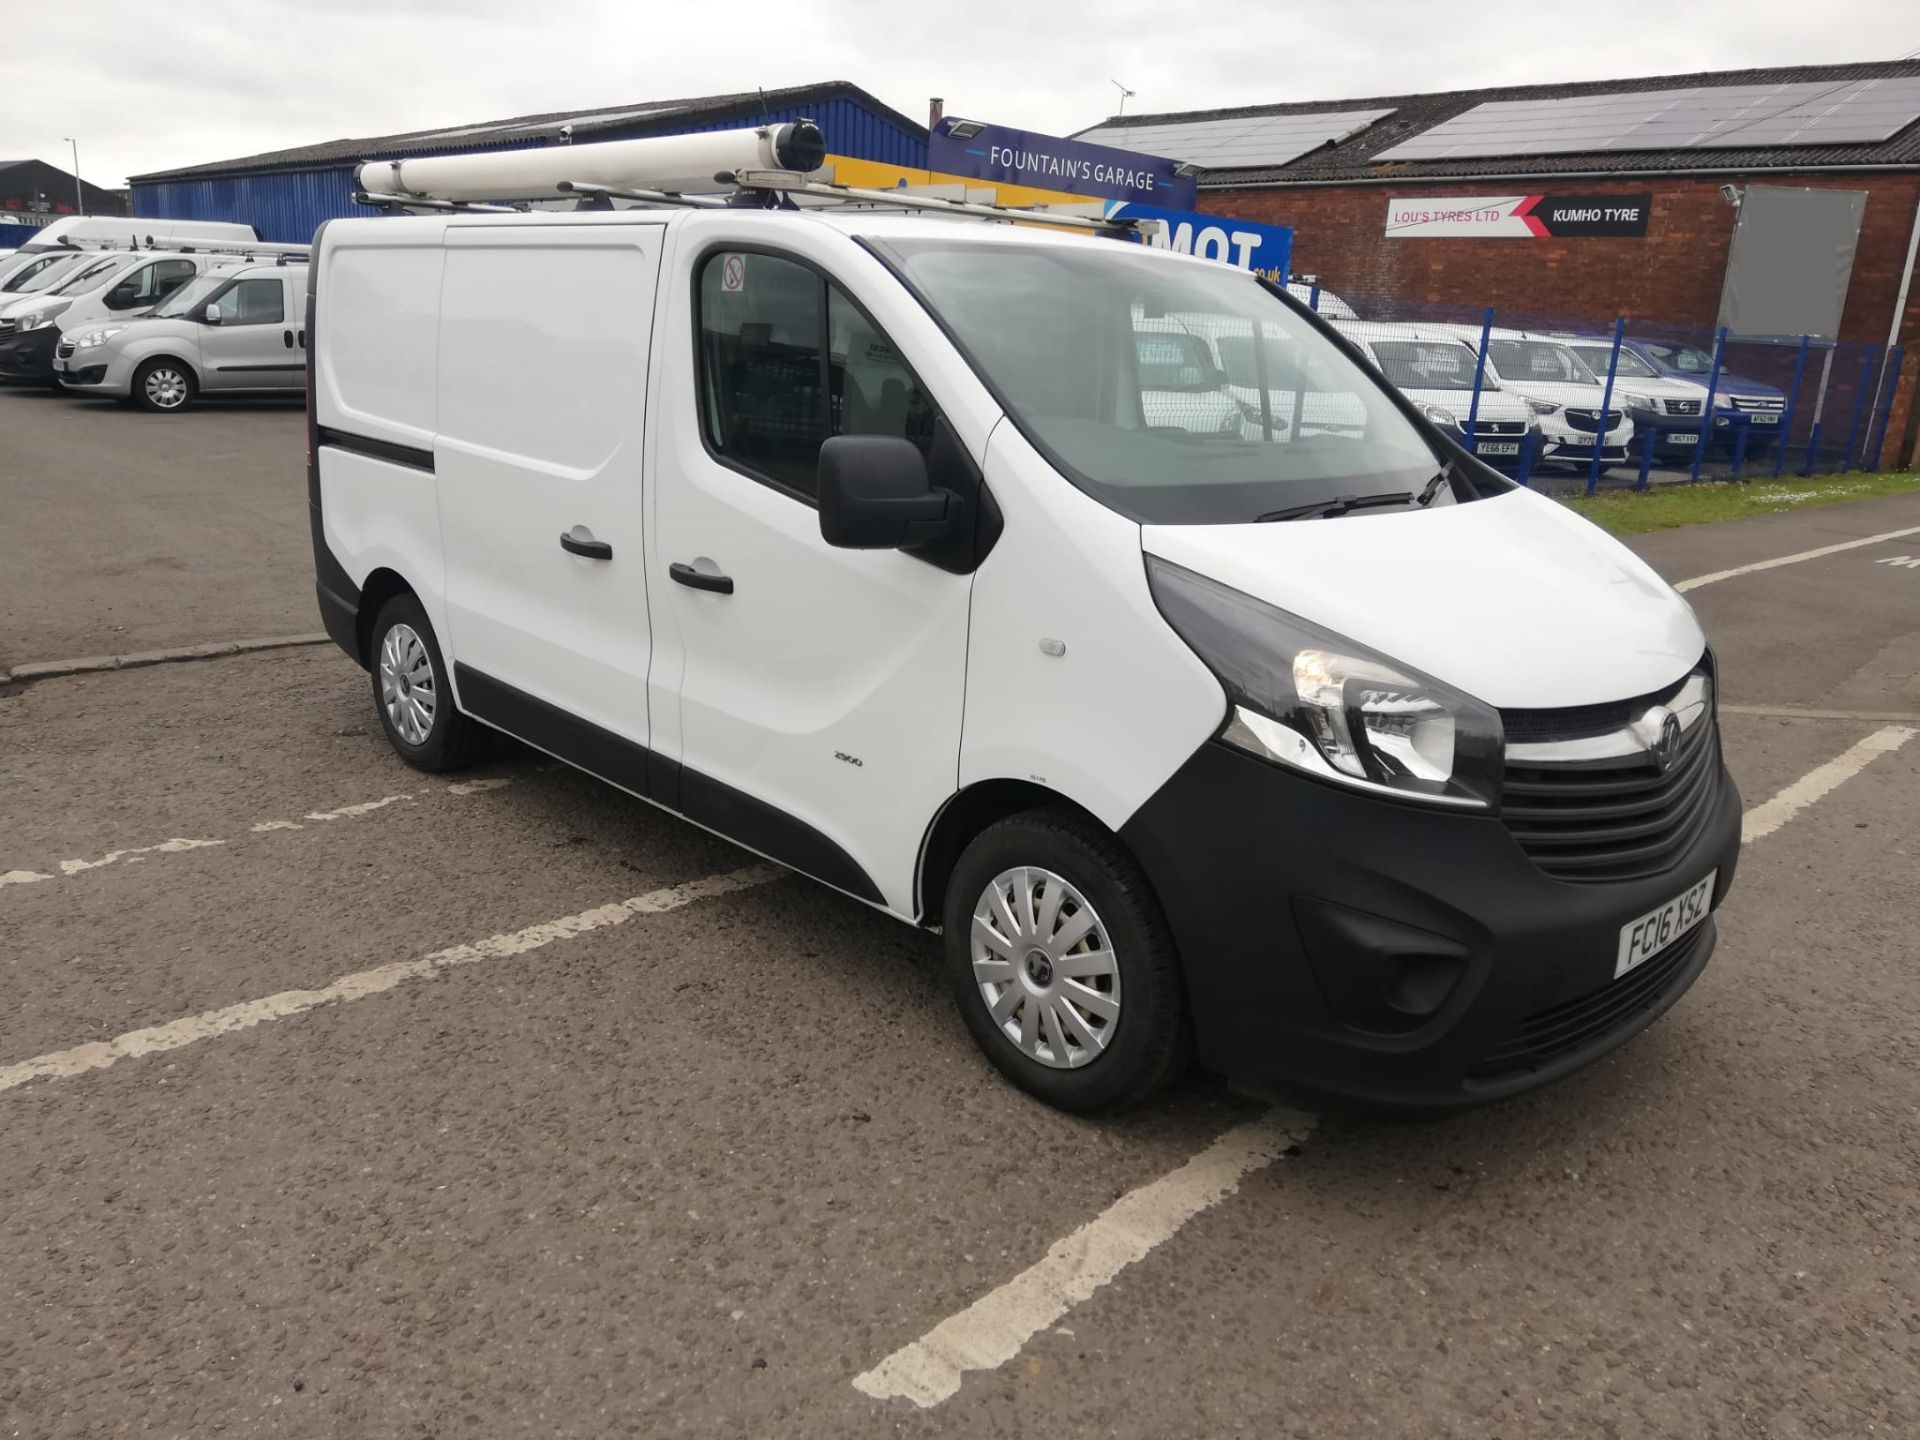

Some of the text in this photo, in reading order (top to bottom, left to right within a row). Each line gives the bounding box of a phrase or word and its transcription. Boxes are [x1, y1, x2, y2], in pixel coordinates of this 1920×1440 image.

[990, 145, 1154, 191] FOUNTAIN'S GARAGE
[1394, 210, 1500, 223] LOU'S TYRES LTD
[1553, 208, 1640, 222] KUMHO TYRE
[1152, 218, 1263, 271] MOT
[1627, 880, 1708, 965] FC16 XSZ
